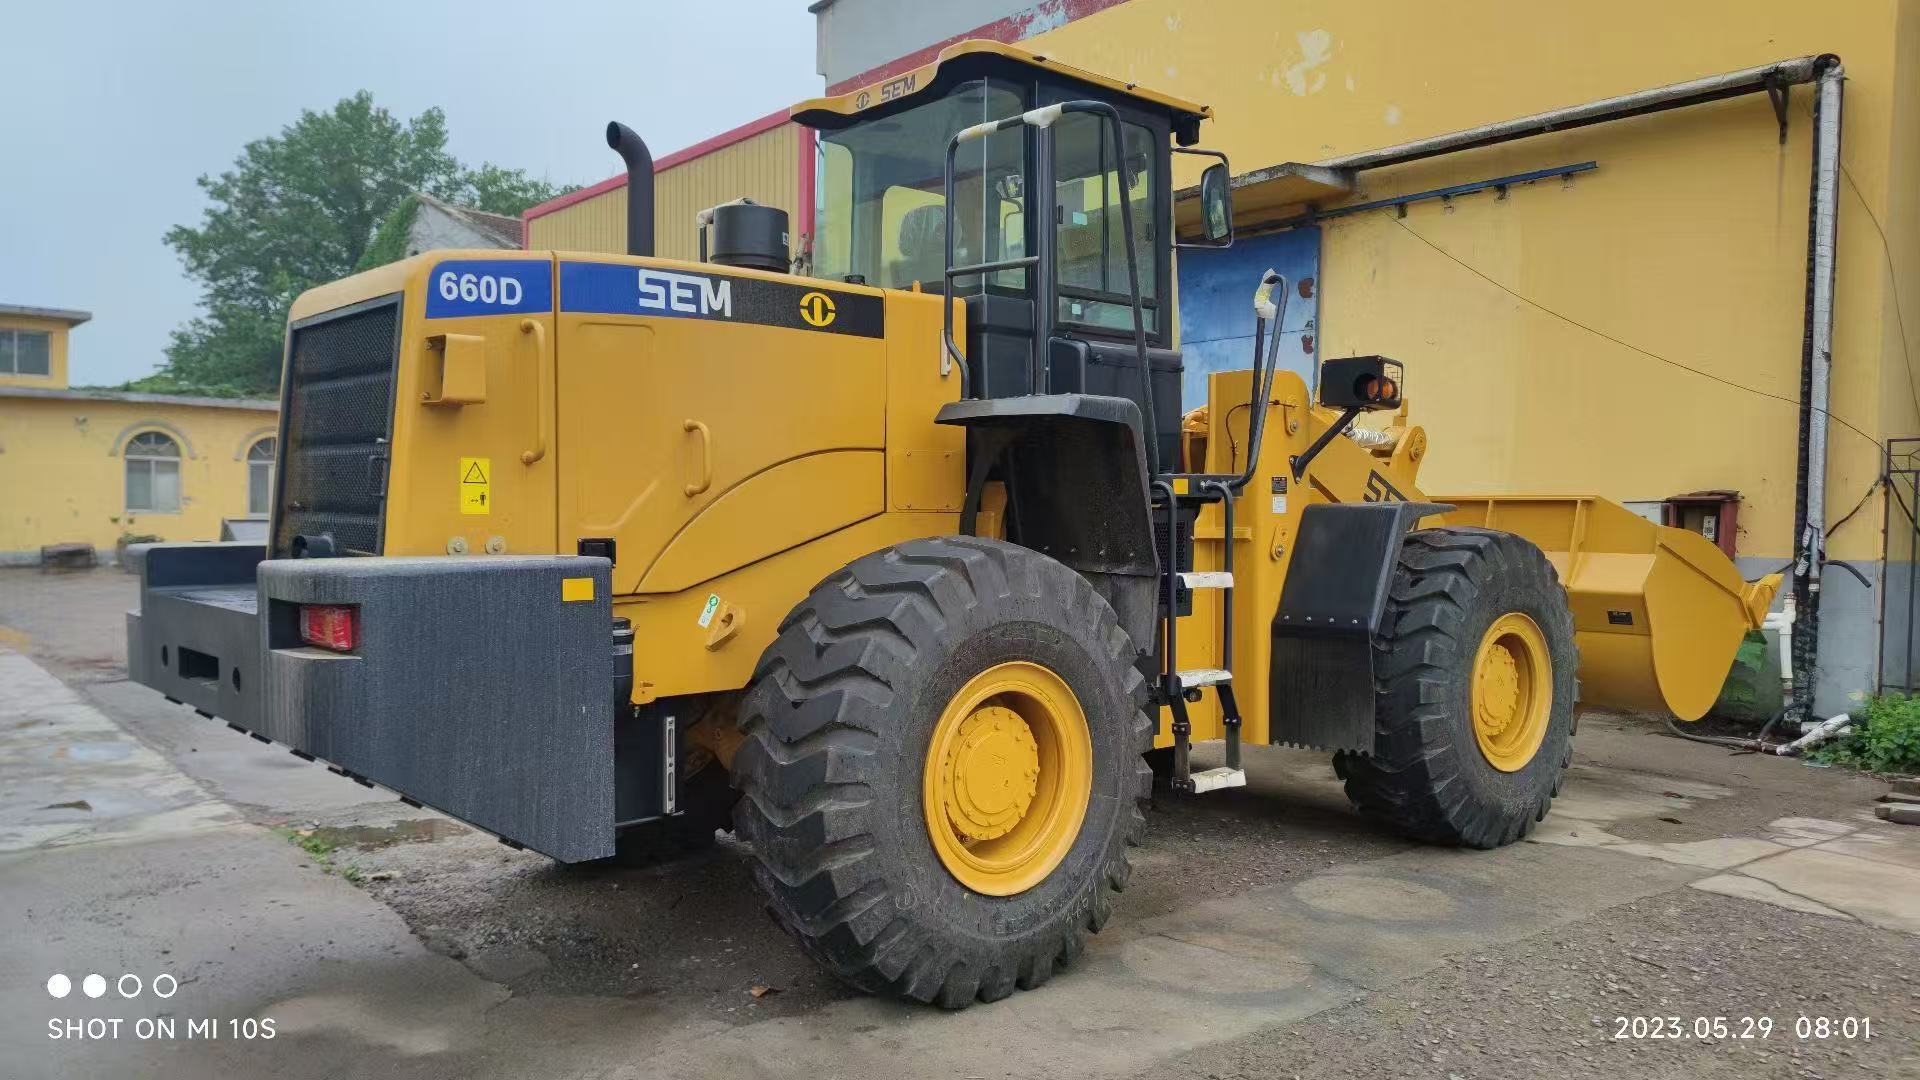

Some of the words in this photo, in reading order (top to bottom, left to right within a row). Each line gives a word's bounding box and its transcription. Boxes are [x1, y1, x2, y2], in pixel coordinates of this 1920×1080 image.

[881, 74, 916, 102] SEM
[439, 271, 523, 306] 660D
[638, 268, 732, 317] SEM
